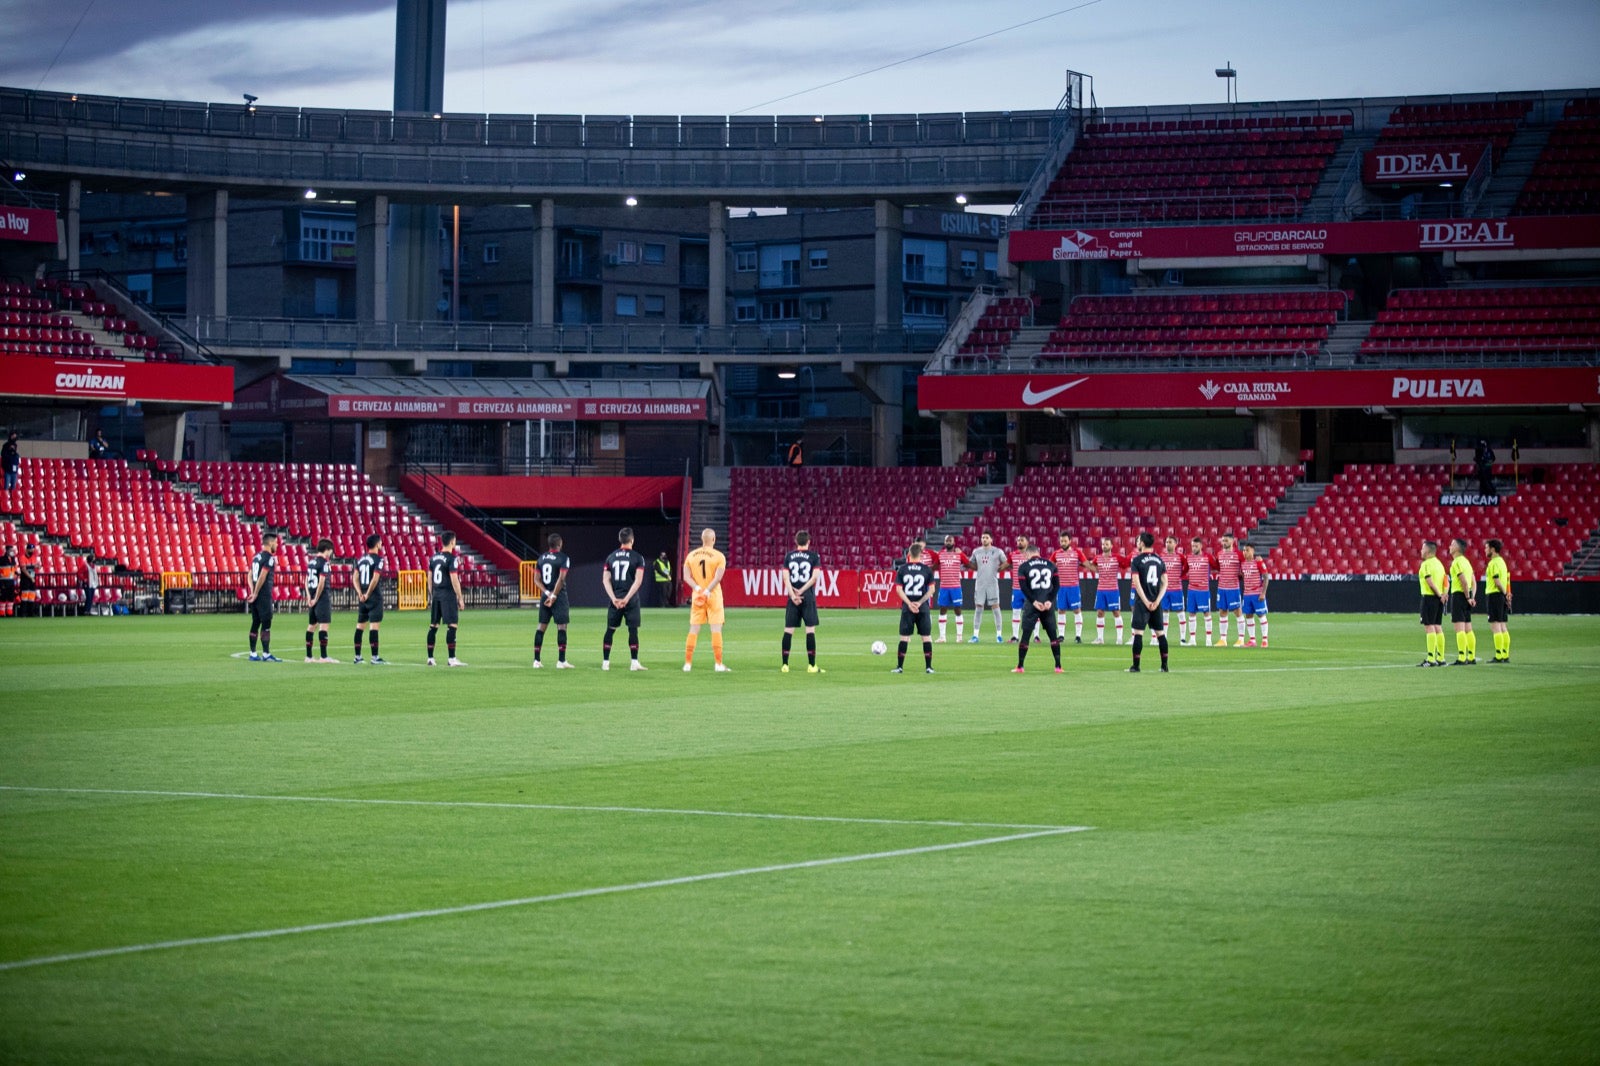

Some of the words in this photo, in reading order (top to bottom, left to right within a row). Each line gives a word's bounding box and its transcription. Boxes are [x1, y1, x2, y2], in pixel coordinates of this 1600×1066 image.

[1376, 153, 1468, 175] IDEAL
[8, 213, 29, 234] Hoy
[941, 214, 980, 234] OSUNA
[1420, 222, 1514, 244] IDEAL
[1109, 230, 1142, 239] Compost
[1110, 249, 1131, 258] Paper
[1292, 242, 1324, 250] SERVICIO
[1223, 382, 1250, 393] CAJA
[1252, 382, 1291, 393] RURAL
[1237, 393, 1277, 401] GRANADA
[1392, 377, 1485, 398] PULEVA
[353, 401, 392, 412] CERVEZAS
[394, 402, 438, 413] ALHAMBRA
[473, 402, 515, 414] CERVEZAS
[517, 403, 563, 414] ALHAMBRA
[600, 403, 642, 414] CERVEZAS
[644, 403, 692, 415] ALHAMBRA
[1441, 495, 1498, 505] #FANCAM
[359, 564, 370, 585] 11
[433, 564, 442, 584] 6
[542, 563, 552, 584] 8
[612, 560, 630, 581] 17
[699, 560, 706, 579] 1
[789, 561, 811, 583] 33
[1029, 568, 1052, 590] 23
[1146, 565, 1158, 586] 4
[1365, 574, 1400, 582] #FANCAM
[742, 569, 839, 596] WINAX
[903, 574, 925, 596] 22
